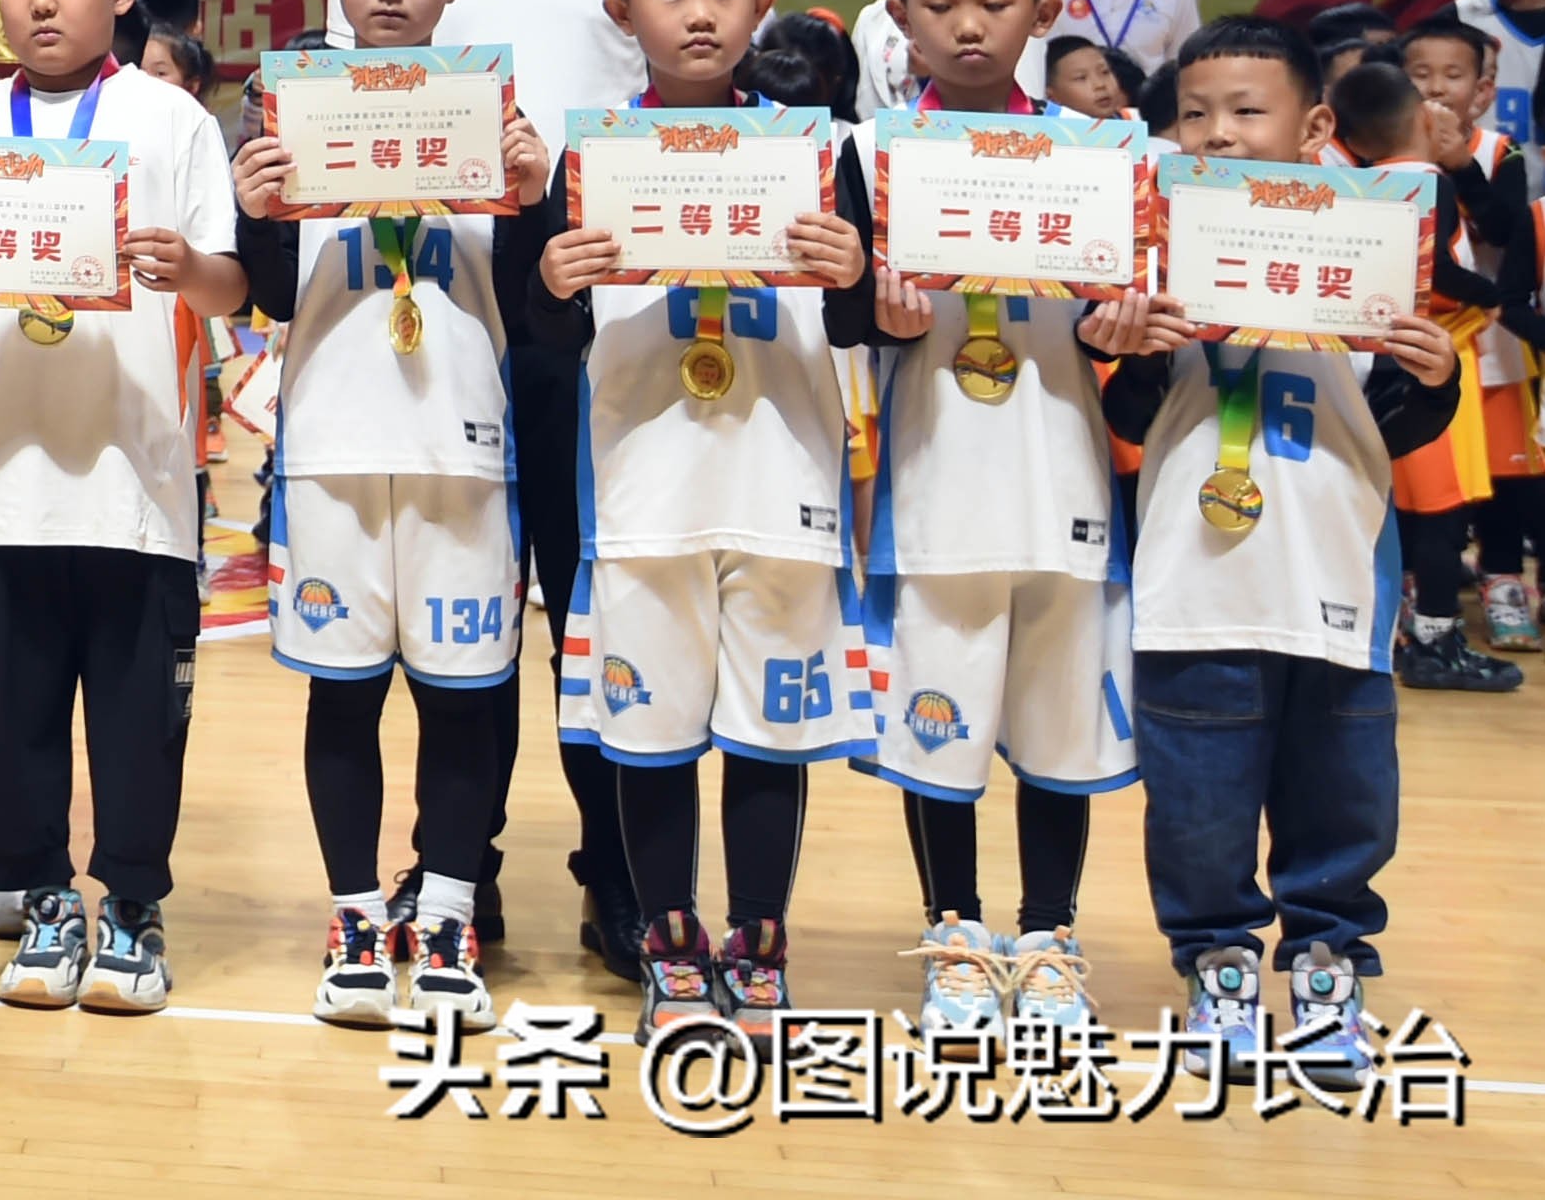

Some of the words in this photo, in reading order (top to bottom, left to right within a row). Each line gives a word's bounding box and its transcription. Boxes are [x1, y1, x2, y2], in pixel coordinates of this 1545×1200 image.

[325, 137, 448, 169] 二等奖
[631, 204, 762, 236] 二等奖
[938, 208, 1073, 246] 二等奖
[1214, 257, 1354, 300] 二等奖
[426, 595, 503, 645] 134
[763, 649, 833, 724] 65
